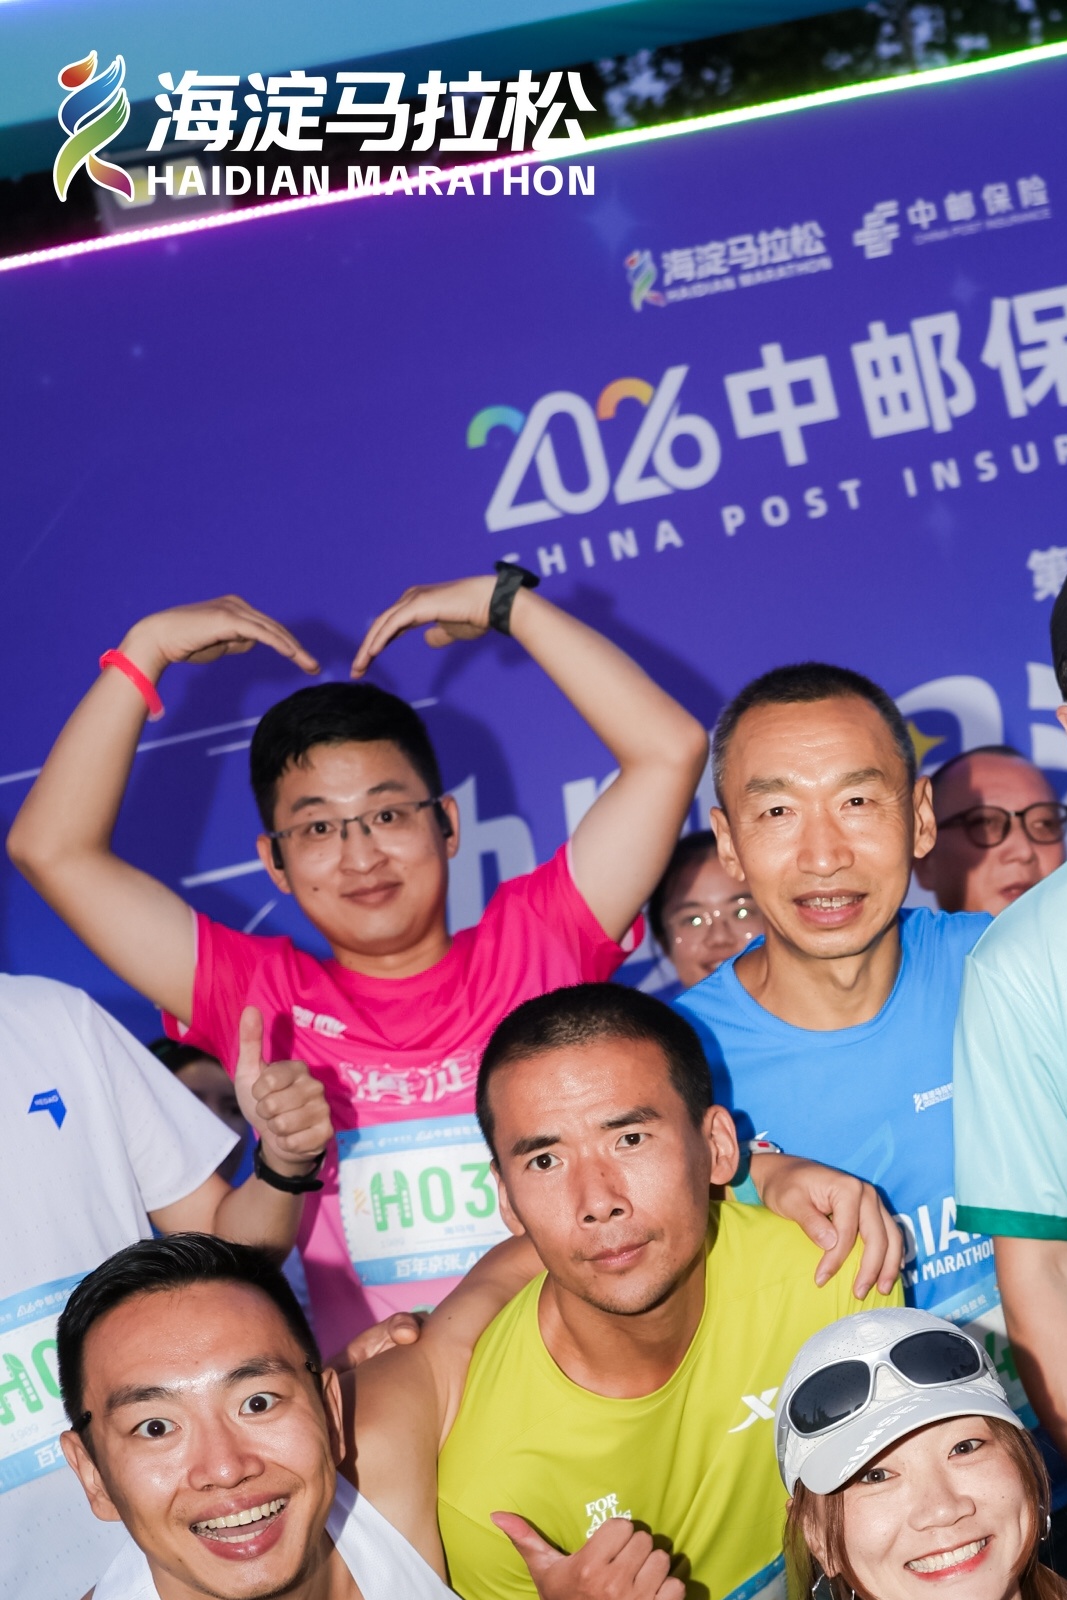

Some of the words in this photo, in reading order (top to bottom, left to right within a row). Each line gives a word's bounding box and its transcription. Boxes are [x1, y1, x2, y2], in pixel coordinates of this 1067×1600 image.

[662, 220, 827, 286] 海淀马拉松
[499, 519, 683, 577] HINA
[721, 478, 863, 536] POST
[892, 1196, 981, 1262] DIA
[585, 1492, 619, 1517] FOR
